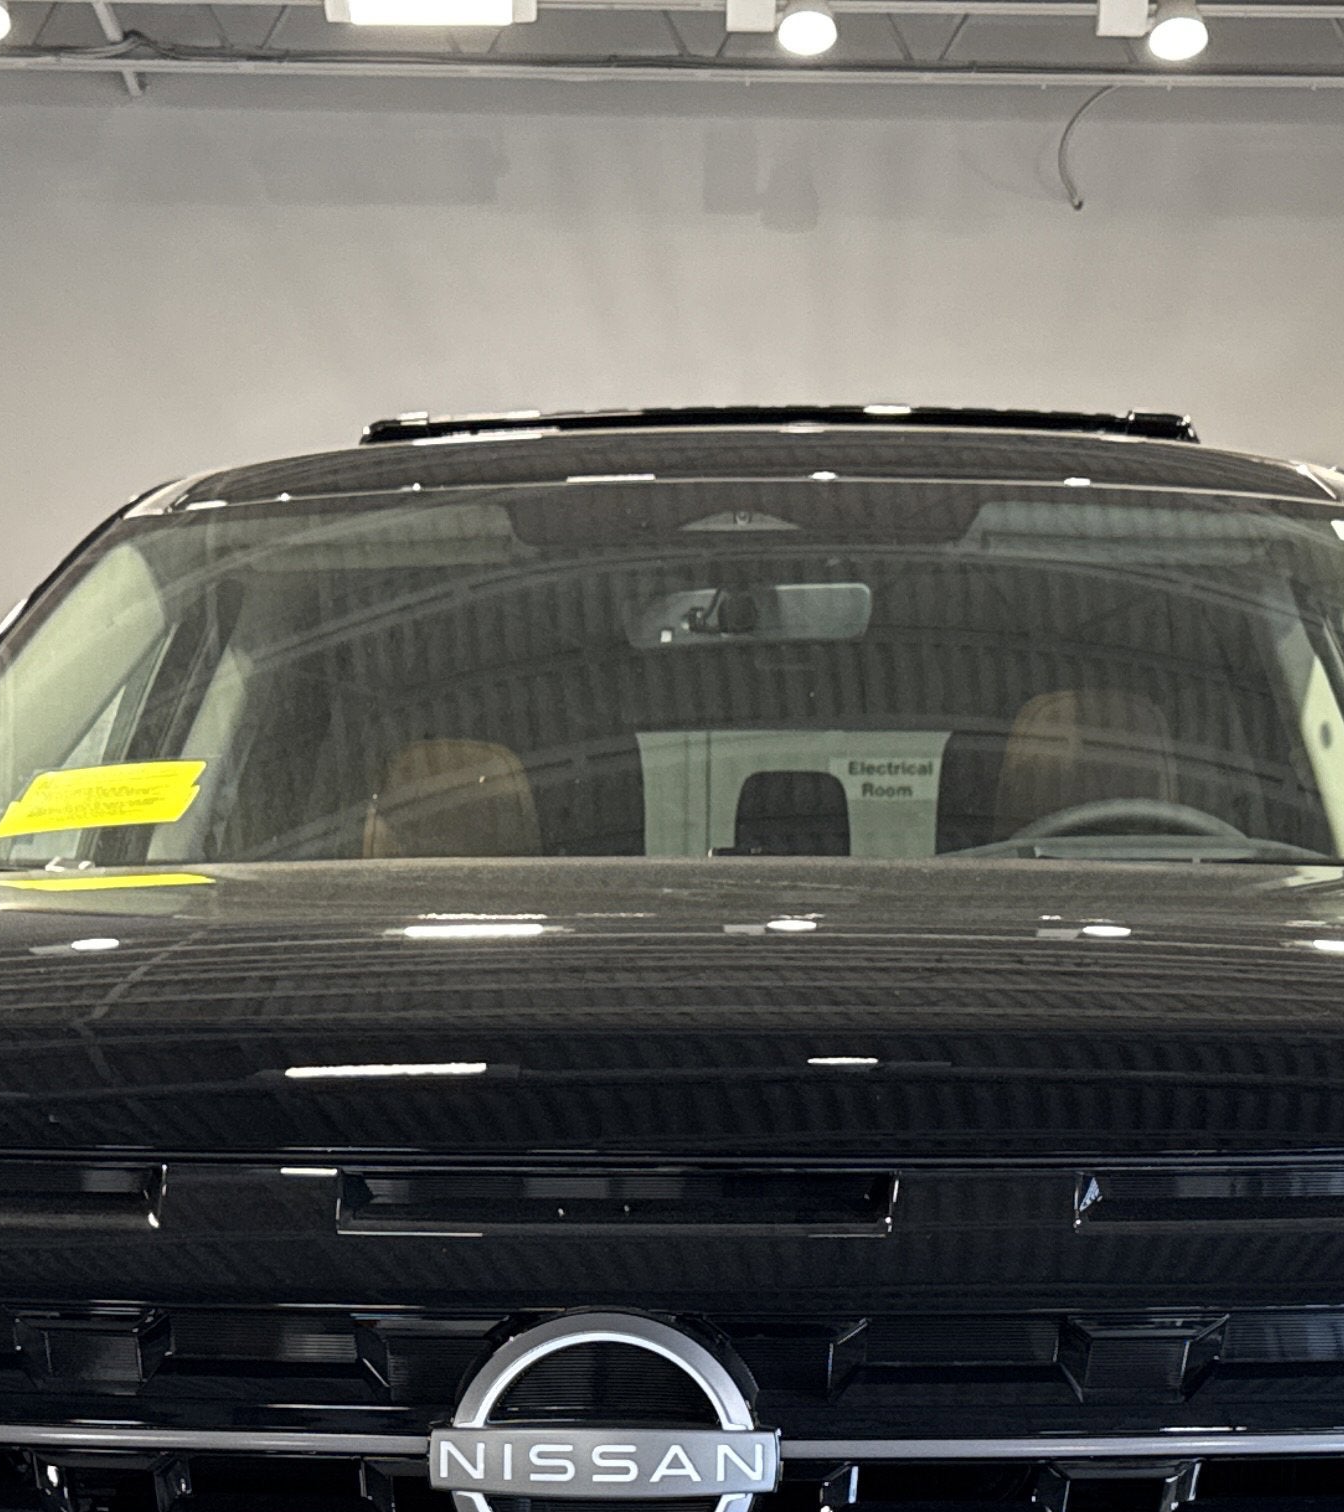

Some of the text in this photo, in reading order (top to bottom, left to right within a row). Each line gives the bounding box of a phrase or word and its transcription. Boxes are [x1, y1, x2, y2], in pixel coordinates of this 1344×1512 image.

[849, 761, 933, 776] Electrical
[862, 783, 913, 797] Room
[439, 1440, 764, 1483] NISSAN
